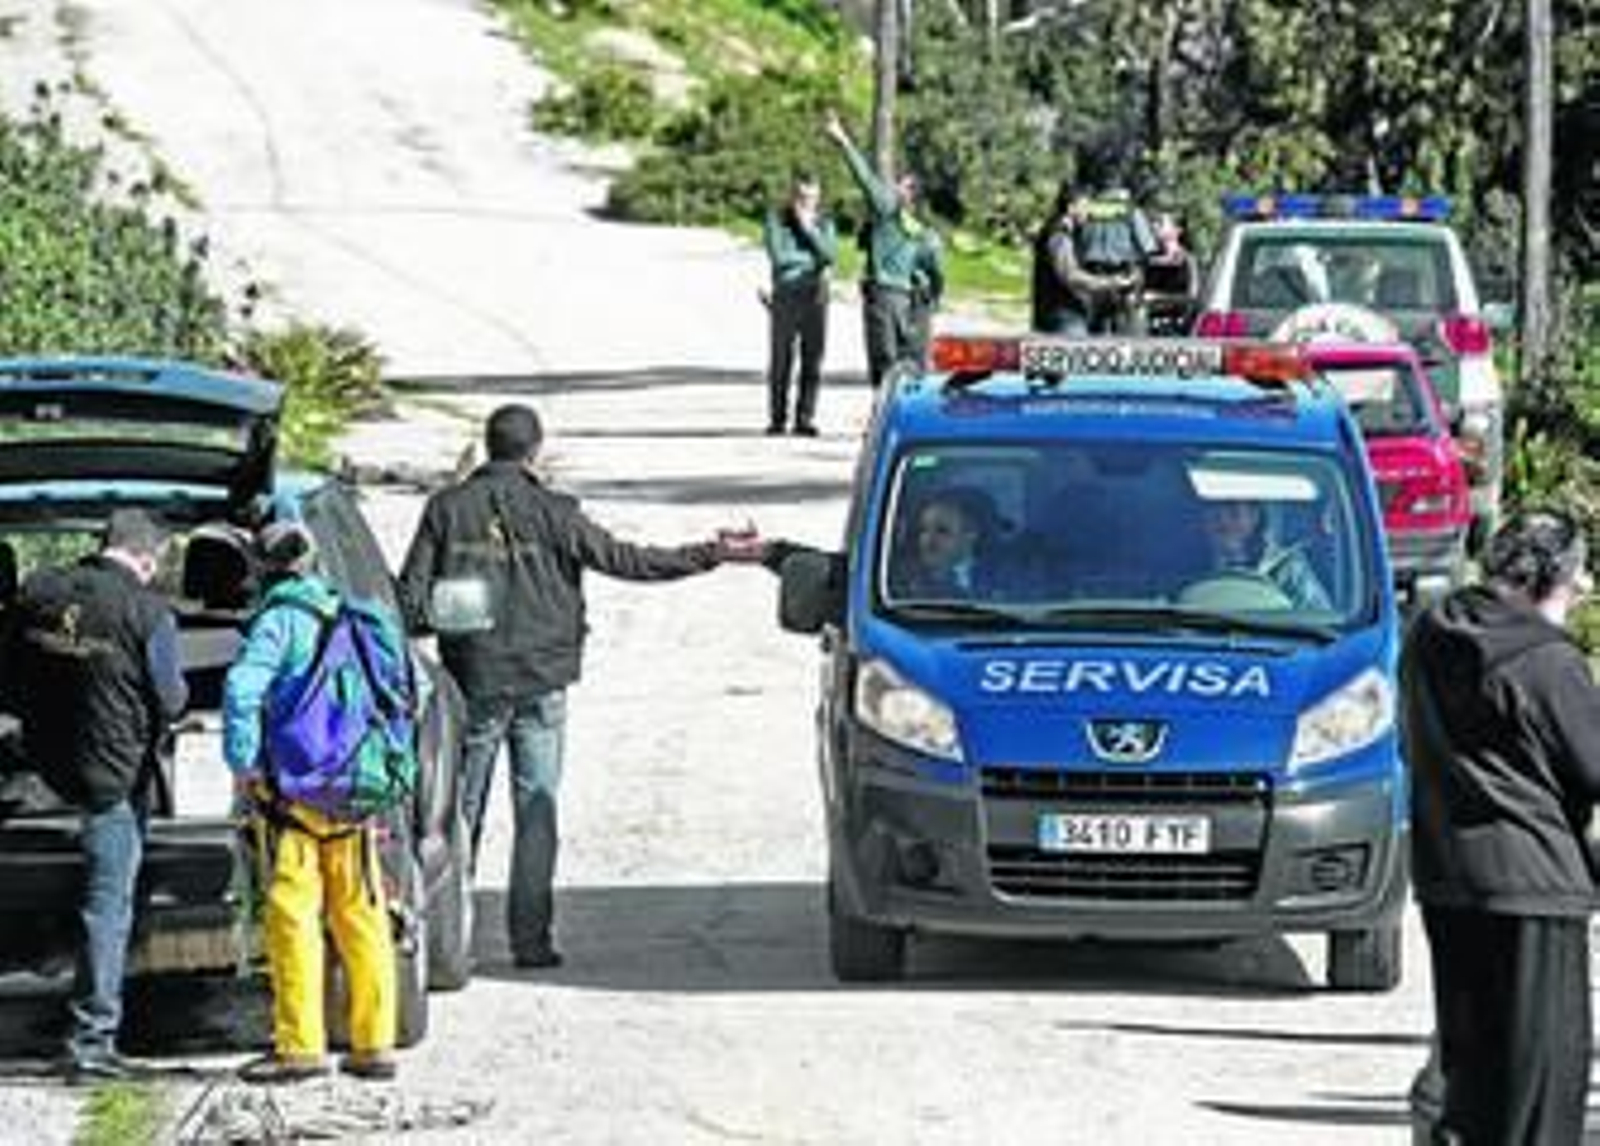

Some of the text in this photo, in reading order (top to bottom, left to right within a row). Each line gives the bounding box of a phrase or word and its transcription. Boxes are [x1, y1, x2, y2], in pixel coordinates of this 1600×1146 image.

[1022, 344, 1121, 375] SERVICIO
[980, 659, 1271, 697] SERVISA
[1062, 818, 1132, 848] 3410
